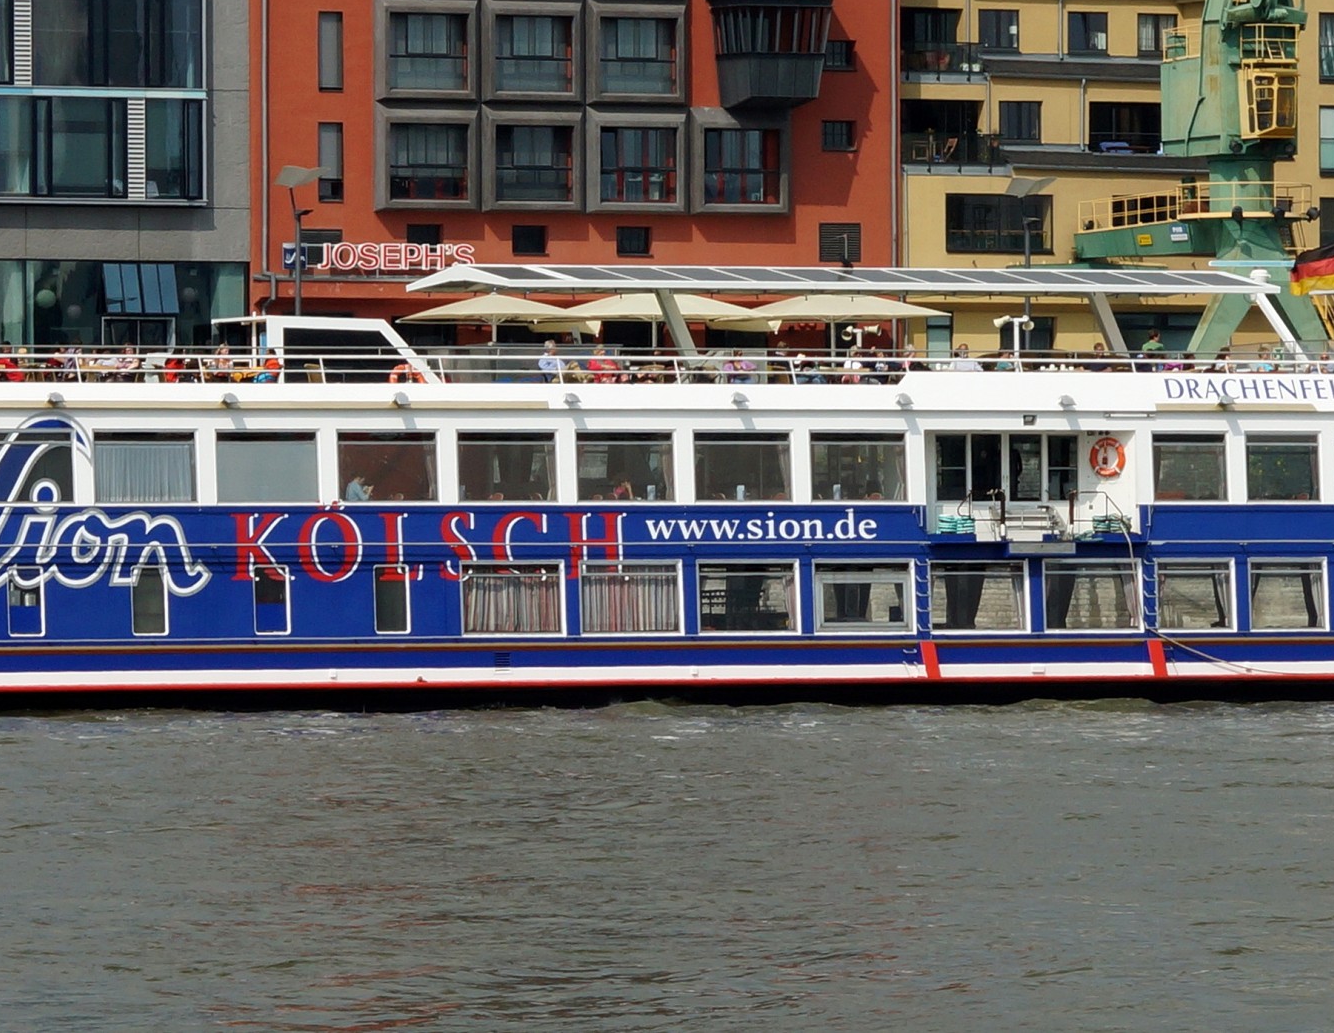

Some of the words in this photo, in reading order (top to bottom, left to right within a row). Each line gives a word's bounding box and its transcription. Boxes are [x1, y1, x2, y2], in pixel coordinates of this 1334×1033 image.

[317, 242, 475, 270] JOSEPH'S
[230, 498, 629, 583] KÖLSCH
[645, 508, 878, 540] www.sion.de
